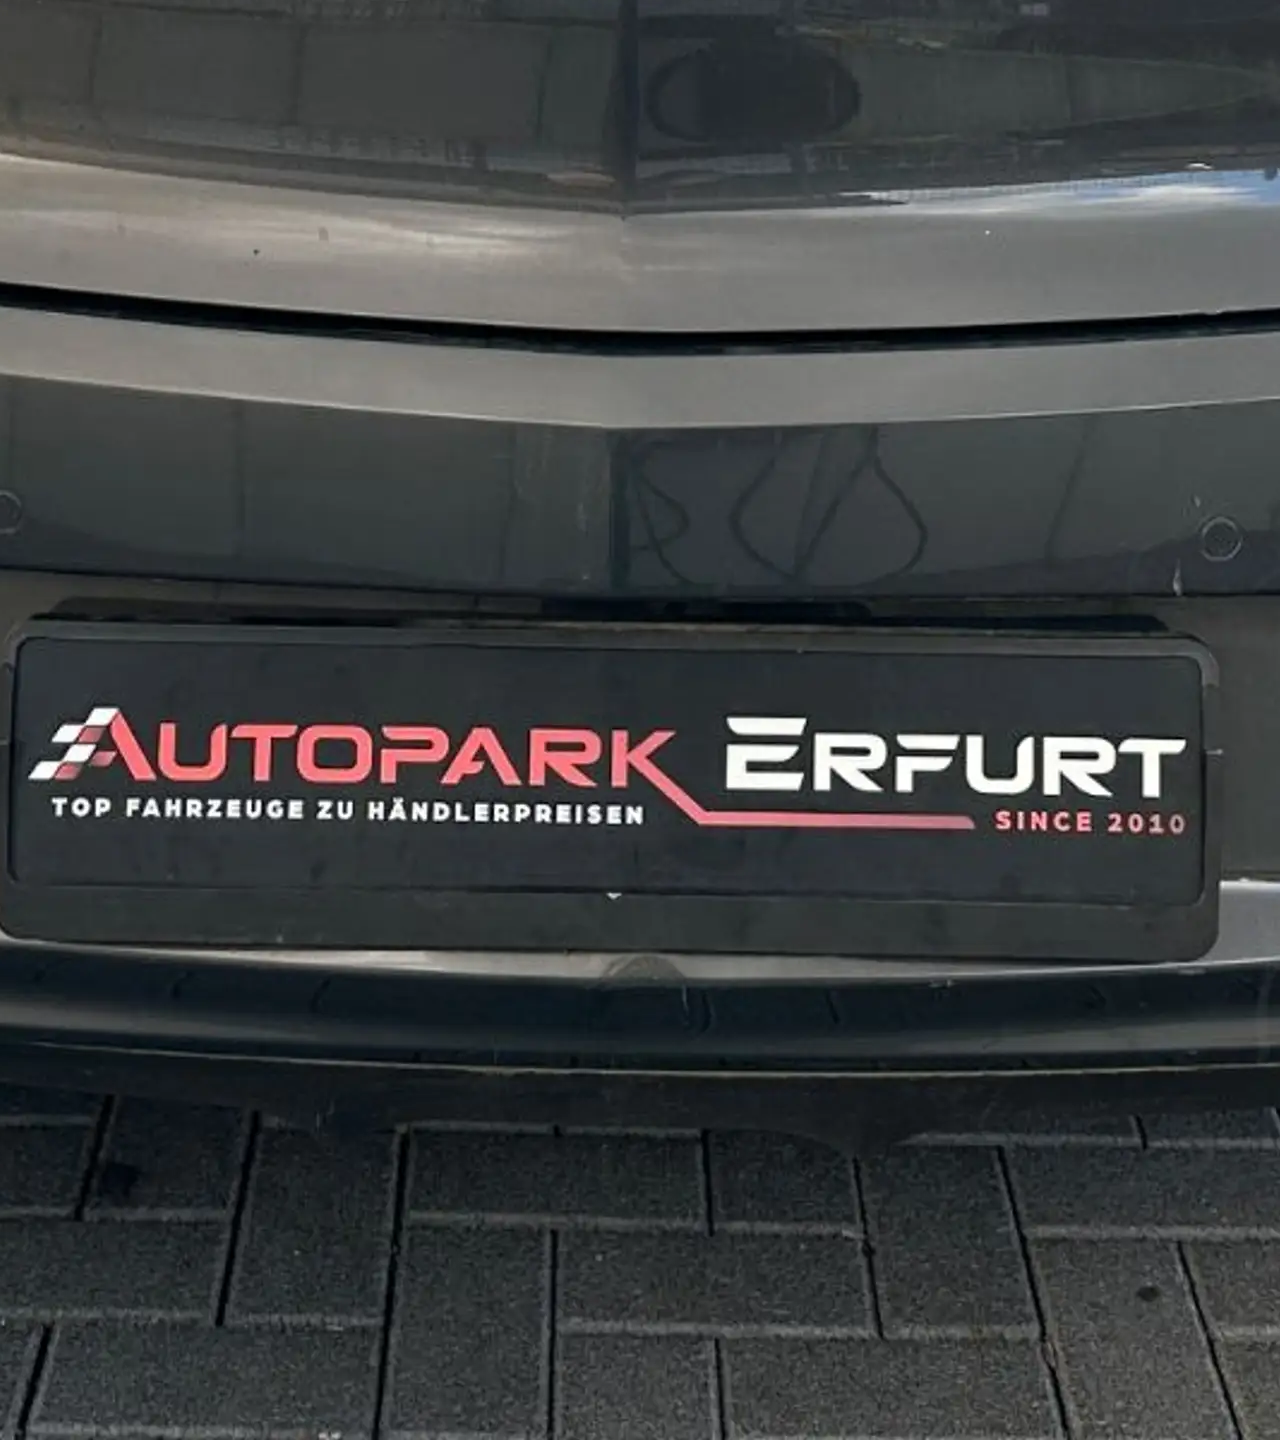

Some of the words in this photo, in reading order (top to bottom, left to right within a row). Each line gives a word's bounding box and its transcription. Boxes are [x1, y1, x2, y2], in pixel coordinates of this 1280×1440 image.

[29, 707, 677, 788] AUTOPARK
[725, 716, 1188, 798] ERFURT
[51, 797, 111, 817] TOP
[126, 797, 305, 820] FAHRZEUGE
[317, 800, 354, 820] ZU
[367, 796, 645, 826] HÄNDLERPREISEN
[995, 810, 1094, 833] SINCE
[1107, 812, 1187, 835] 2010
